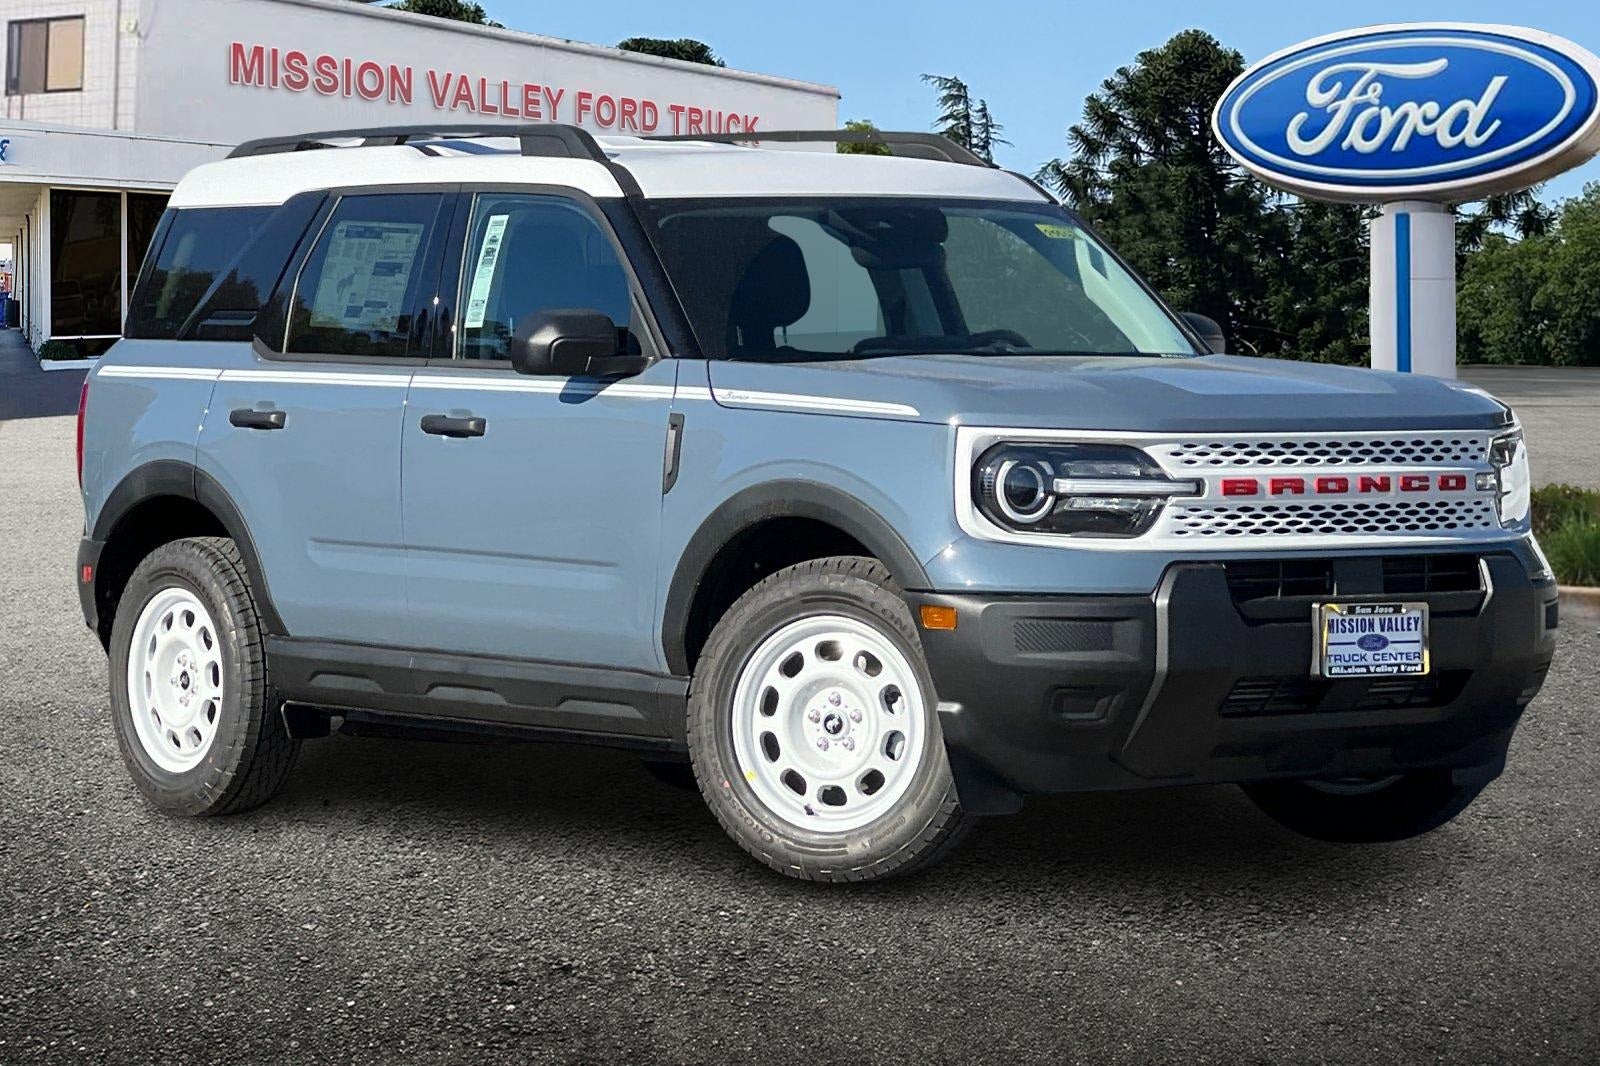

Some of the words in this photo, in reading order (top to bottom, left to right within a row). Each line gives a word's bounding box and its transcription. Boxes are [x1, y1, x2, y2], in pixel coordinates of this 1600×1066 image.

[229, 41, 413, 105] MISSION
[428, 69, 564, 121] VALLEY
[576, 90, 658, 134] FORD
[669, 104, 761, 145] TRUCK
[1286, 57, 1509, 156] Ford
[1221, 475, 1467, 496] BRONCO
[1355, 605, 1372, 614] San
[1373, 604, 1394, 614] Jose
[1327, 617, 1375, 634] MISSION
[1379, 616, 1420, 633] VALLEY
[1328, 653, 1367, 663] TRUCK
[1372, 651, 1421, 662] CENTER
[1331, 665, 1367, 674] Mission
[1368, 664, 1399, 674] Valley
[1400, 663, 1422, 672] Ford
